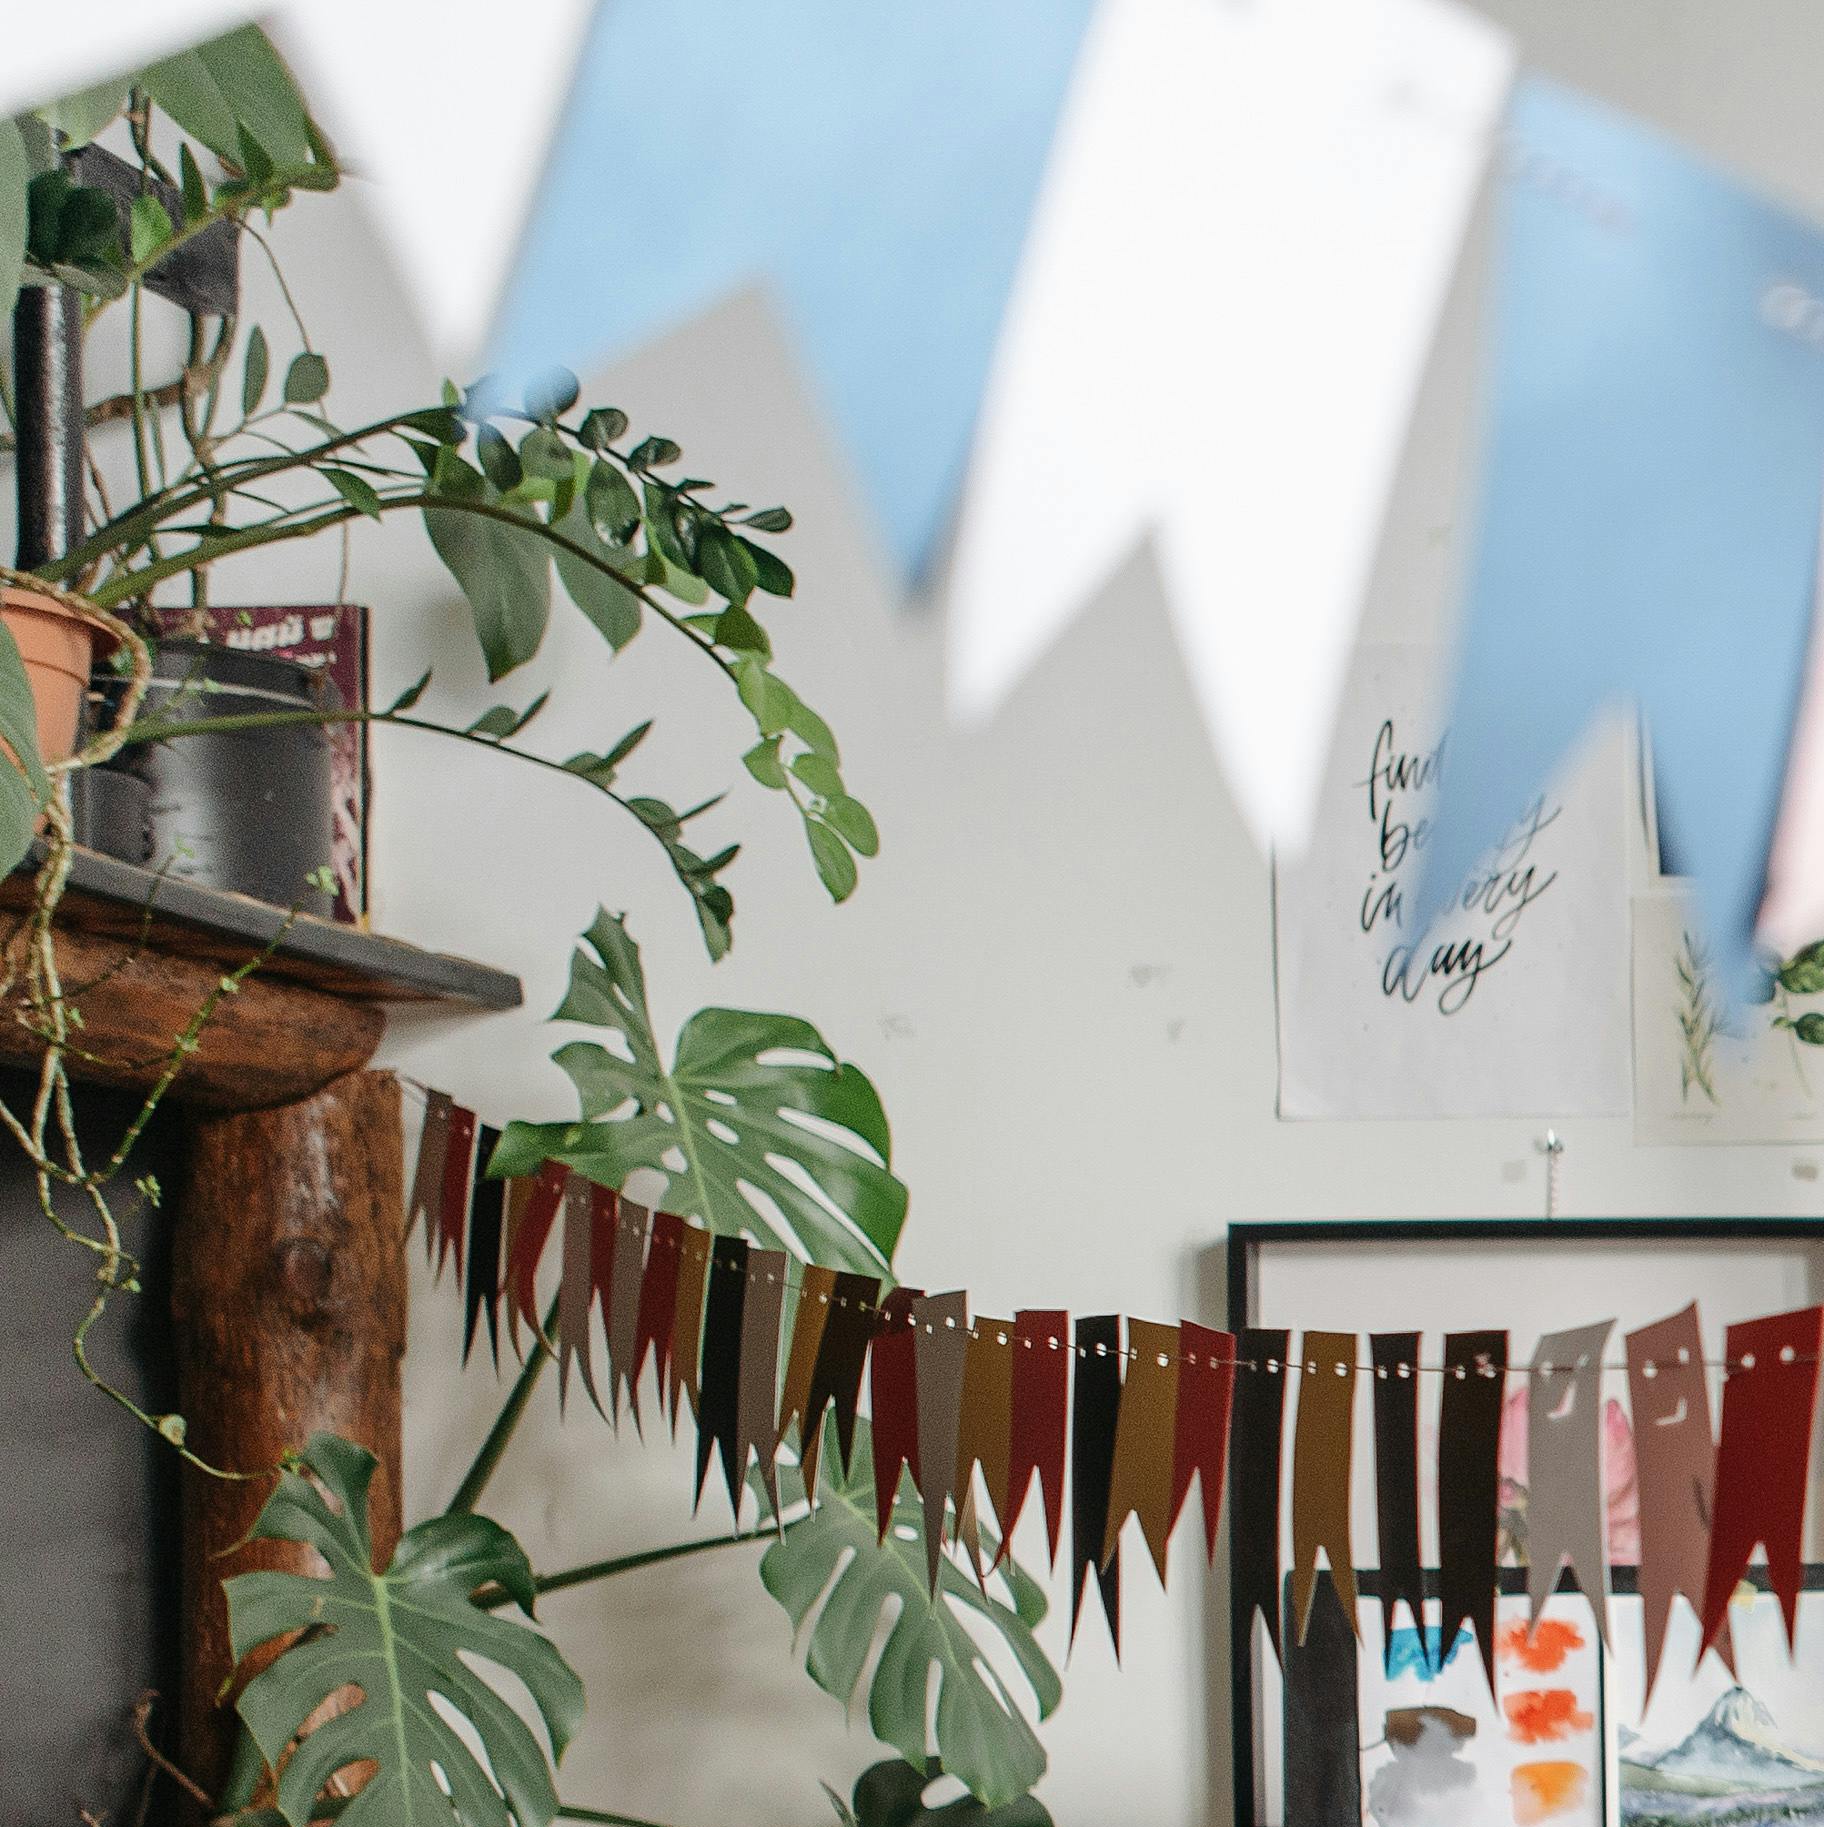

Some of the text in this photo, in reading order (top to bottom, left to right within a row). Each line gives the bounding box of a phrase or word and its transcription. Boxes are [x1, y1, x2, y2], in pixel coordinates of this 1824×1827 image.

[1380, 794, 1562, 874] bey
[1361, 874, 1404, 934] in
[1382, 938, 1513, 1016] day
